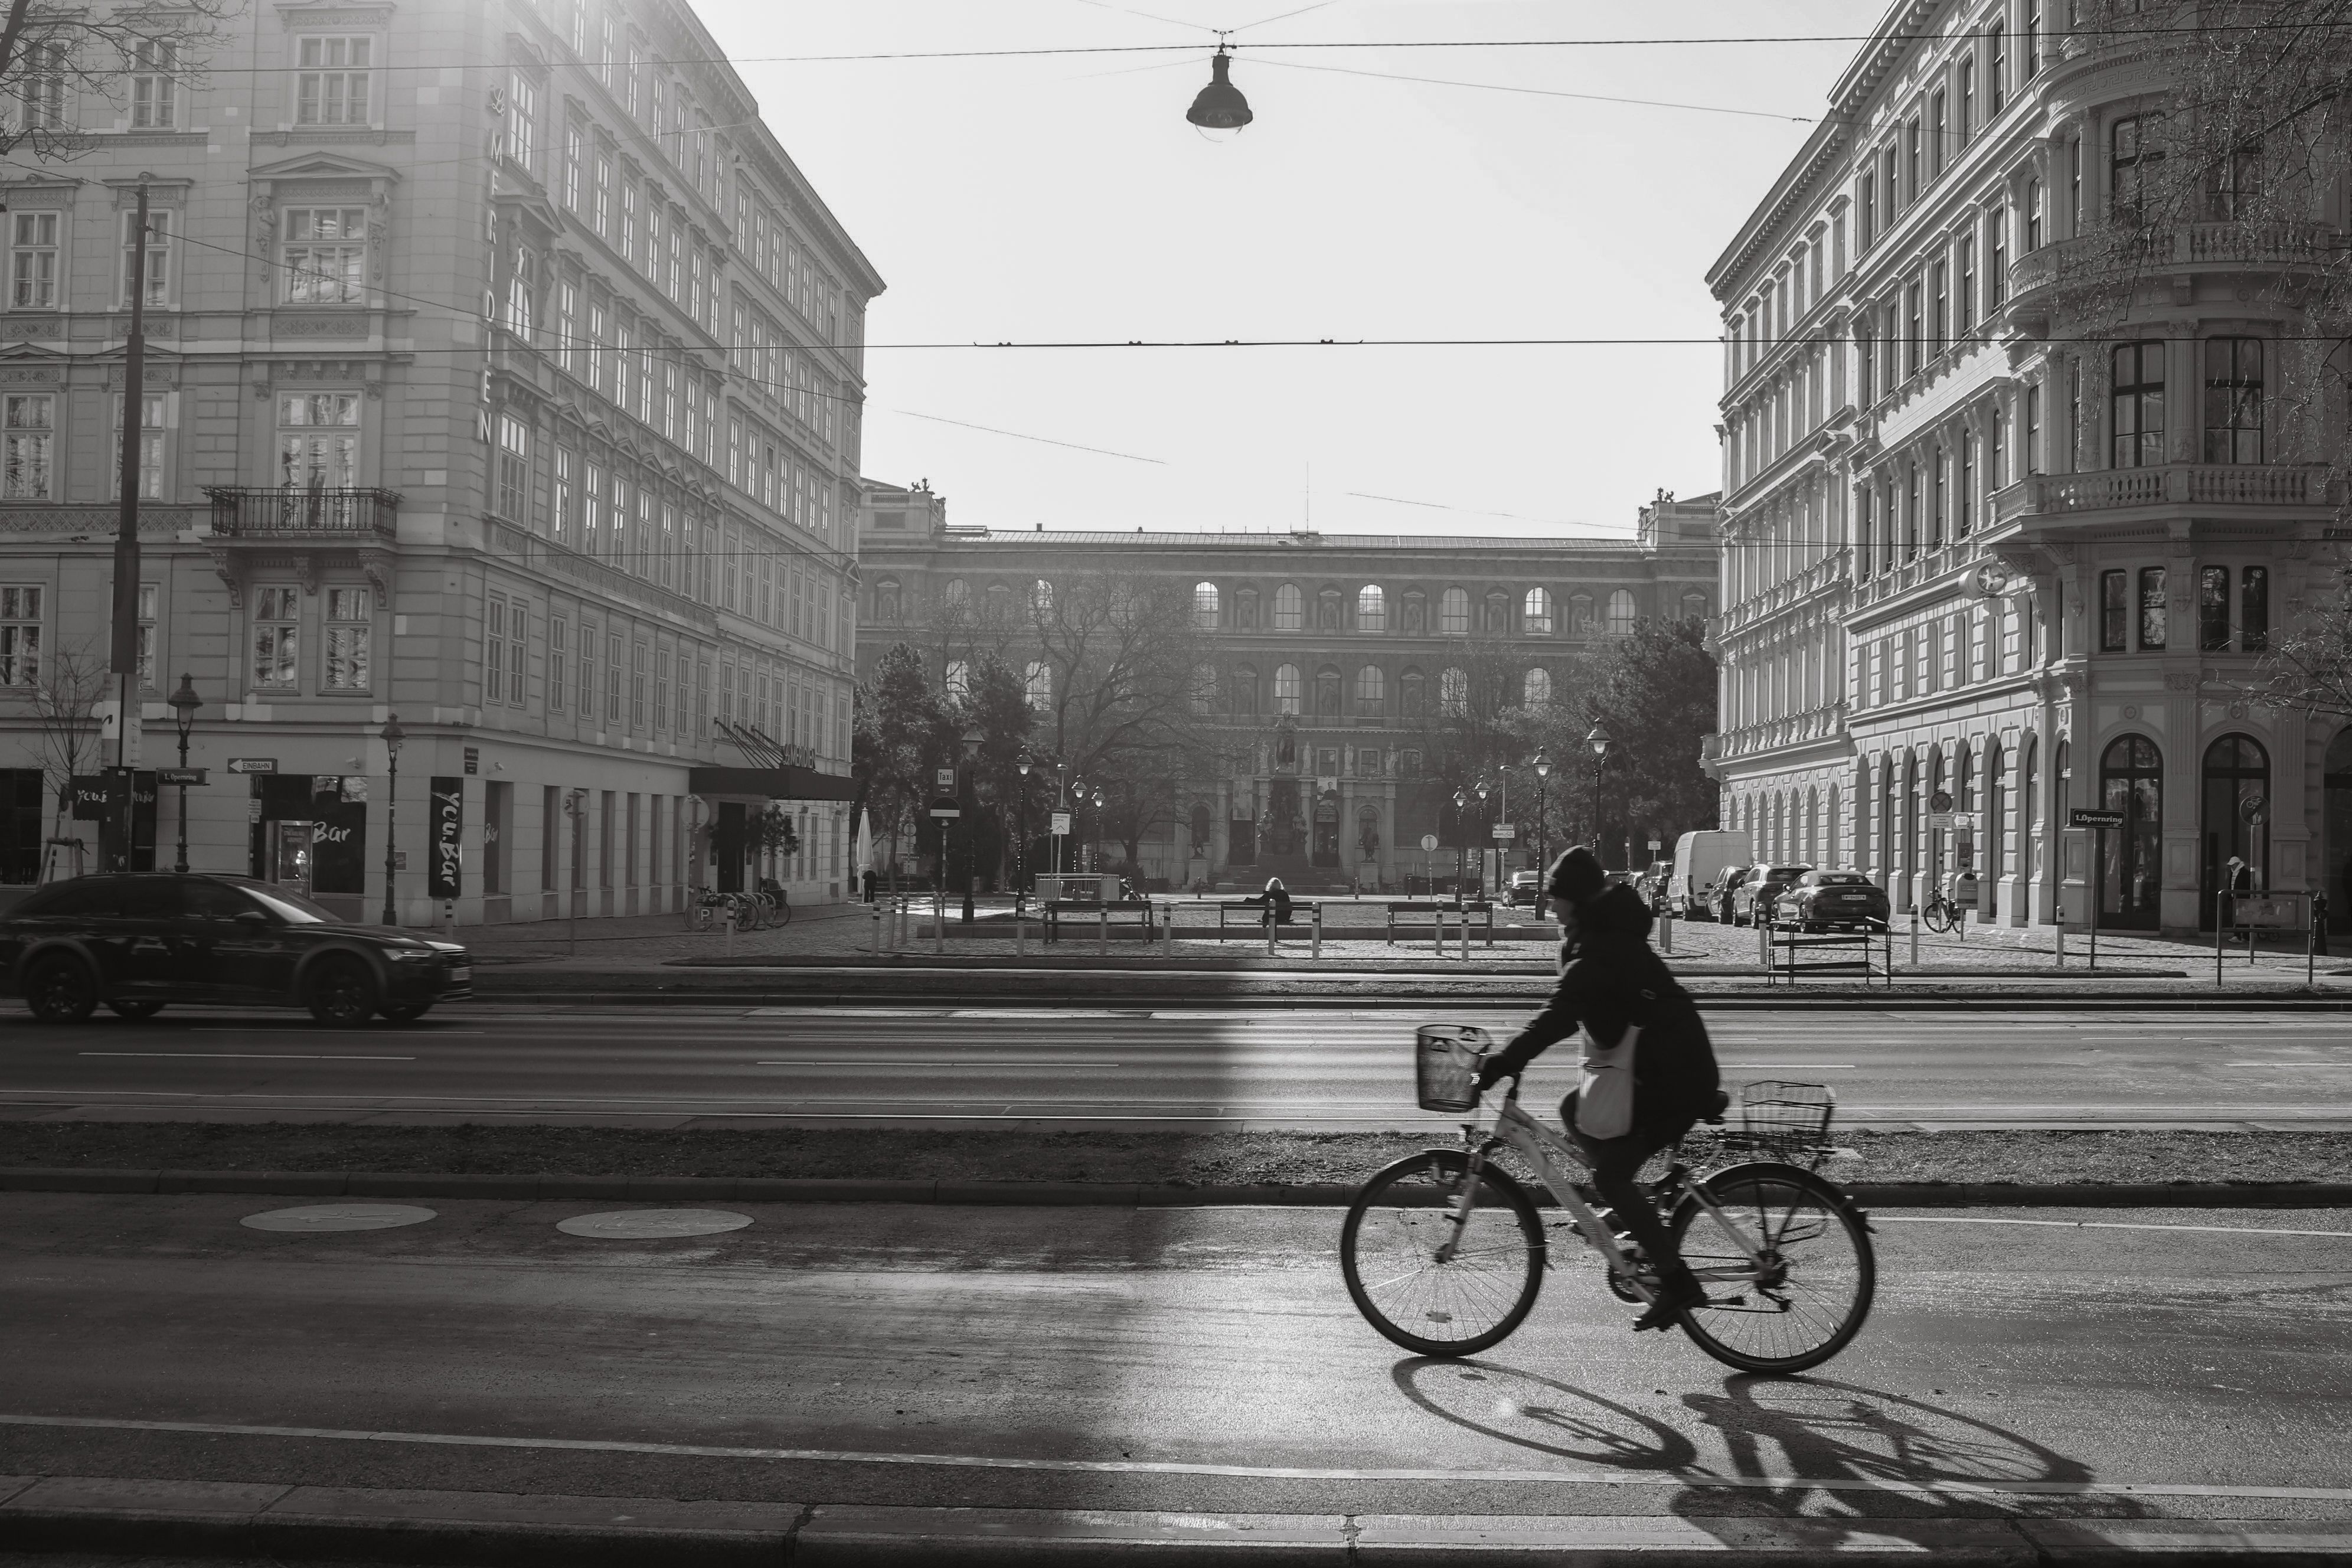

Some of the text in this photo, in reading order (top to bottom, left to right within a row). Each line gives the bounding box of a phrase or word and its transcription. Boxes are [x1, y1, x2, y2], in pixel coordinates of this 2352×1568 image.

[939, 772, 952, 780] Taxi
[485, 822, 498, 844] Bar
[701, 909, 710, 921] P
